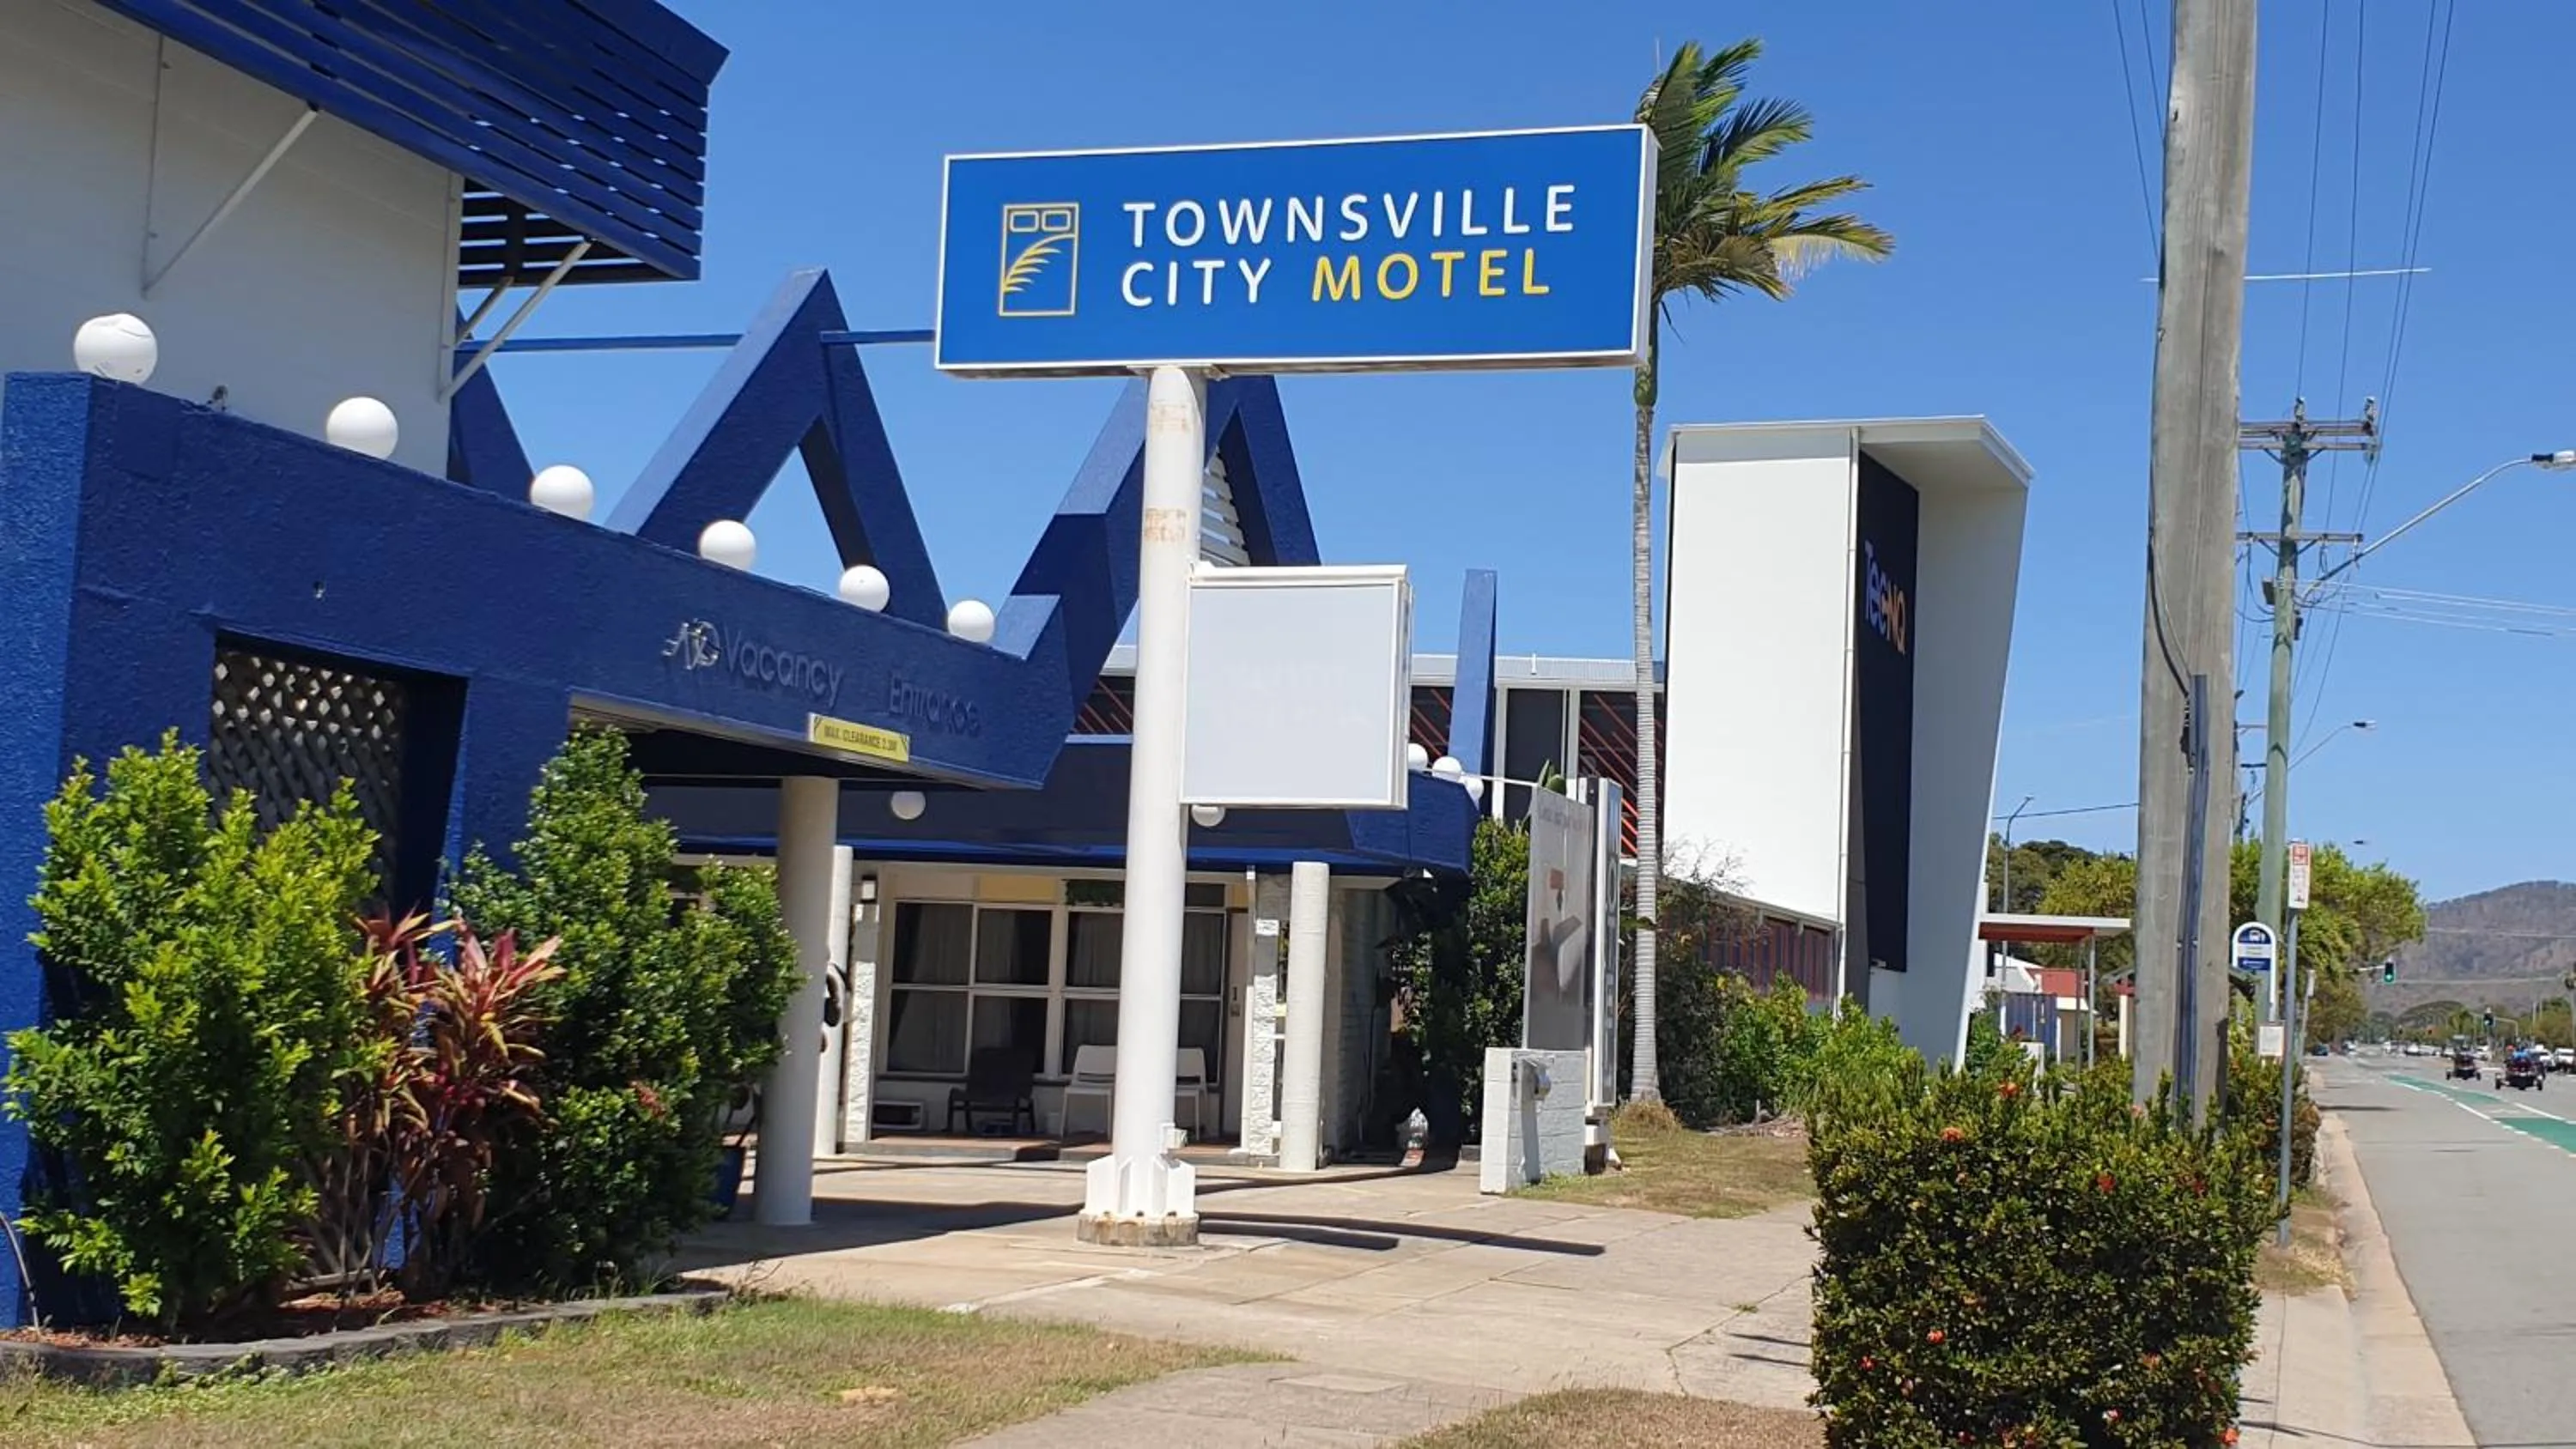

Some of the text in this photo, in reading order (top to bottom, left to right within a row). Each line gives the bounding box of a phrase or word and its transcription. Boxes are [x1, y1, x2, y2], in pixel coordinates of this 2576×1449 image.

[1122, 184, 1576, 248] TOWNSVILLE
[1121, 247, 1550, 306] CITY MOTEL
[722, 621, 844, 709] Vacancy
[890, 670, 981, 737] Entrance
